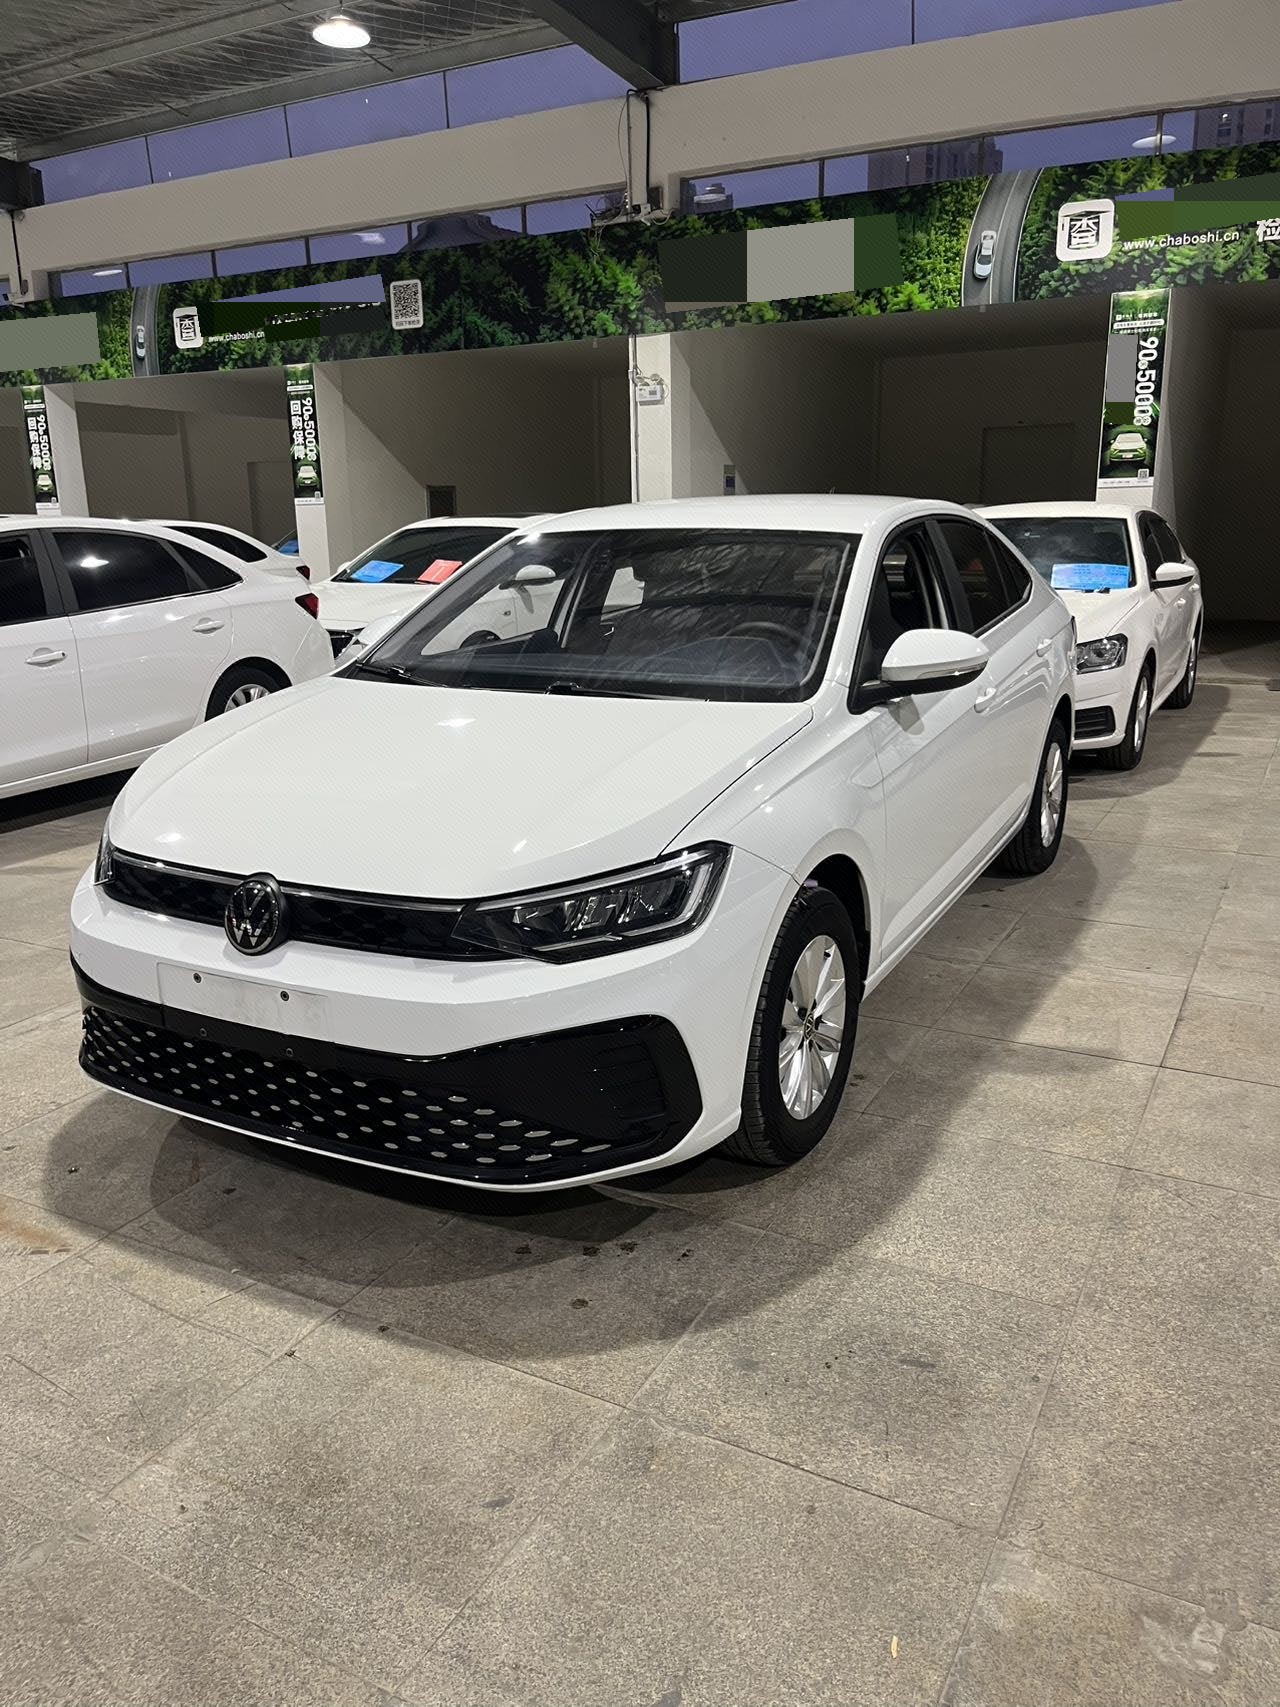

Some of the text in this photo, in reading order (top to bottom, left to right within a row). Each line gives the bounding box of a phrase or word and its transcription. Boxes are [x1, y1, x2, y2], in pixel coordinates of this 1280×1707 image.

[1123, 230, 1240, 250] www.chaboshi.cn
[208, 330, 266, 343] www.chaboshi.cn
[290, 400, 305, 460] 回购保障
